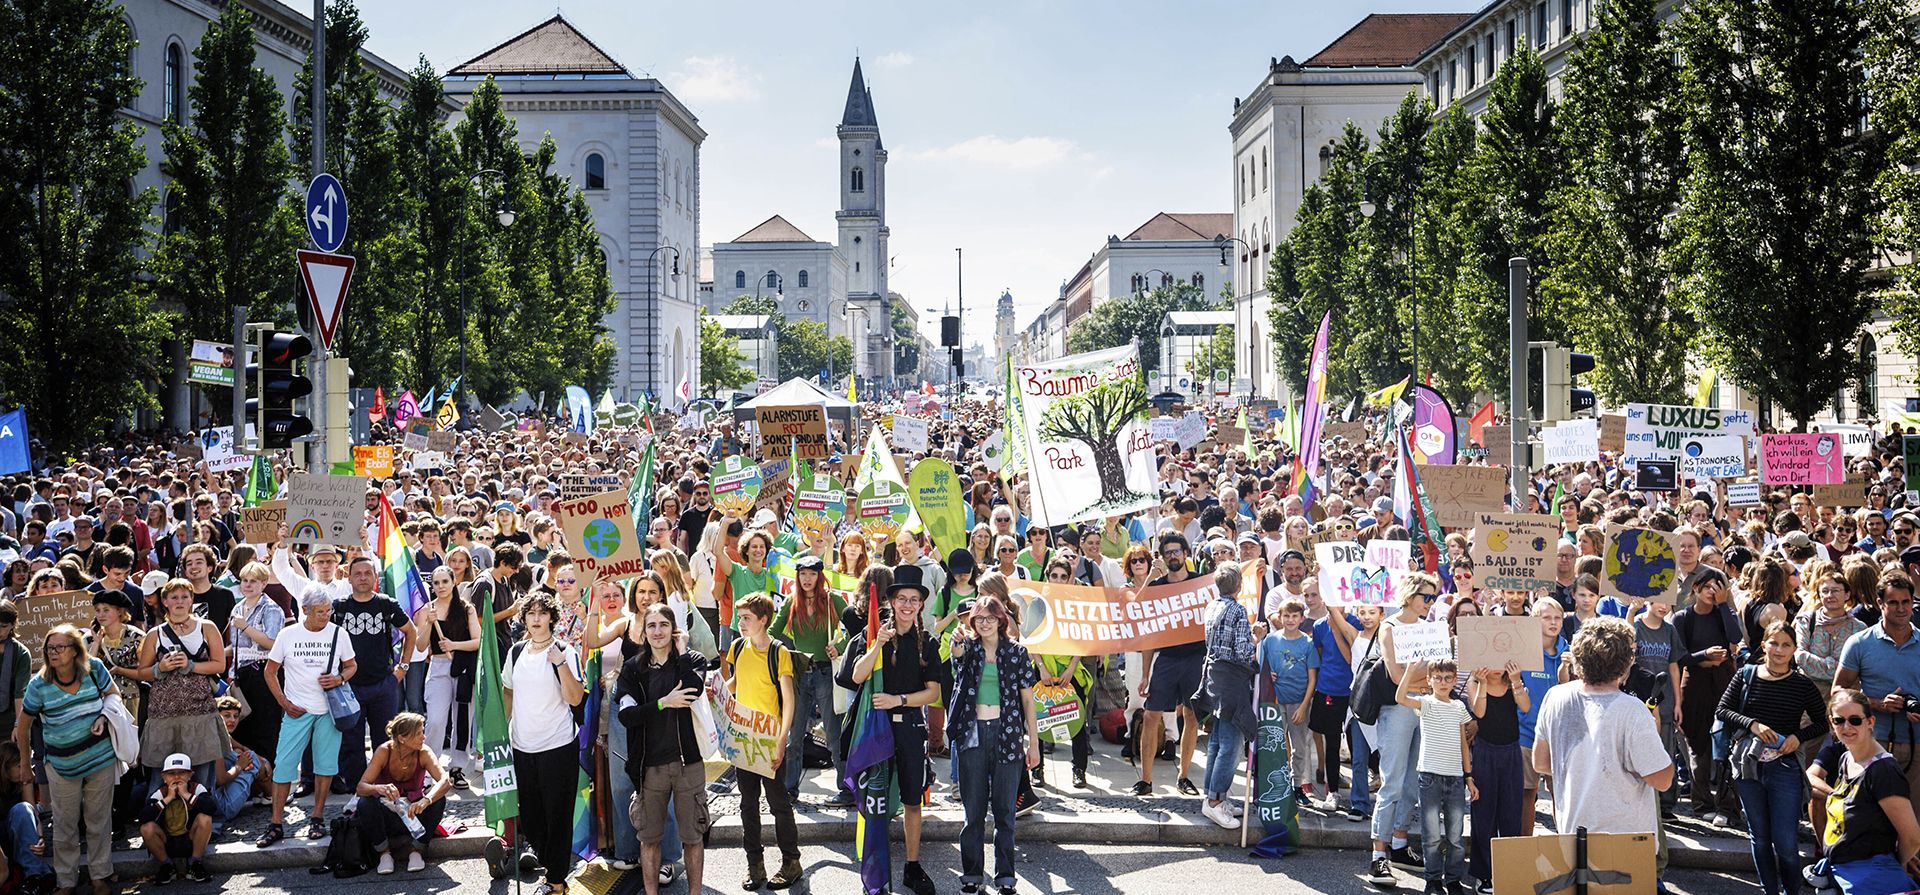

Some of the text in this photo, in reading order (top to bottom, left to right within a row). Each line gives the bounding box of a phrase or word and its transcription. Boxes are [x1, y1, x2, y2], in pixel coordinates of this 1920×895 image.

[193, 365, 224, 376] VEGAN
[820, 370, 829, 378] U
[1022, 367, 1098, 396] Bäume
[761, 409, 819, 424] ALARMSTUFE
[1627, 405, 1749, 430] Der LUXUS geht
[782, 423, 805, 435] ROT
[1555, 425, 1585, 438] OLDIES
[763, 434, 792, 446] SONST
[1626, 433, 1640, 441] uns
[1641, 433, 1653, 442] am
[1765, 435, 1808, 447] Markus,
[1842, 433, 1872, 445] LIMA
[376, 448, 390, 458] Eis
[798, 443, 829, 457] TOT!
[1547, 444, 1596, 458] YOUNGSTERS
[1765, 449, 1779, 458] ich
[1780, 448, 1798, 457] will
[1045, 447, 1085, 469] Park
[1684, 455, 1741, 466] ASTRONOMERS
[1767, 458, 1810, 470] Windrad
[1695, 465, 1720, 477] PLANET
[1723, 464, 1745, 476] EARTH
[562, 477, 585, 485] THE
[1769, 474, 1788, 482] von
[293, 479, 325, 491] Deine
[290, 494, 357, 509] Klimaschutz
[303, 508, 315, 517] JA
[332, 511, 351, 519] NEIN
[564, 500, 627, 519] TOO HOT
[1481, 514, 1503, 526] Wenn
[1332, 545, 1361, 563] DIE
[1369, 546, 1404, 569] UHR
[1525, 557, 1543, 566] IST
[575, 558, 643, 578] TO HANDLE
[1498, 567, 1535, 577] UNSER
[1484, 575, 1557, 592] GAME OVER
[1337, 576, 1399, 604] tick
[25, 601, 30, 614] I
[32, 604, 50, 613] am
[52, 597, 68, 610] the
[1053, 599, 1127, 622] LETZTE
[39, 614, 43, 624] I
[44, 614, 63, 629] speak
[64, 611, 77, 621] for
[77, 610, 89, 620] the
[1056, 621, 1094, 641] VOR
[1097, 621, 1134, 641] DEN
[1411, 647, 1452, 658] MORGEN
[735, 737, 777, 766] TAT
